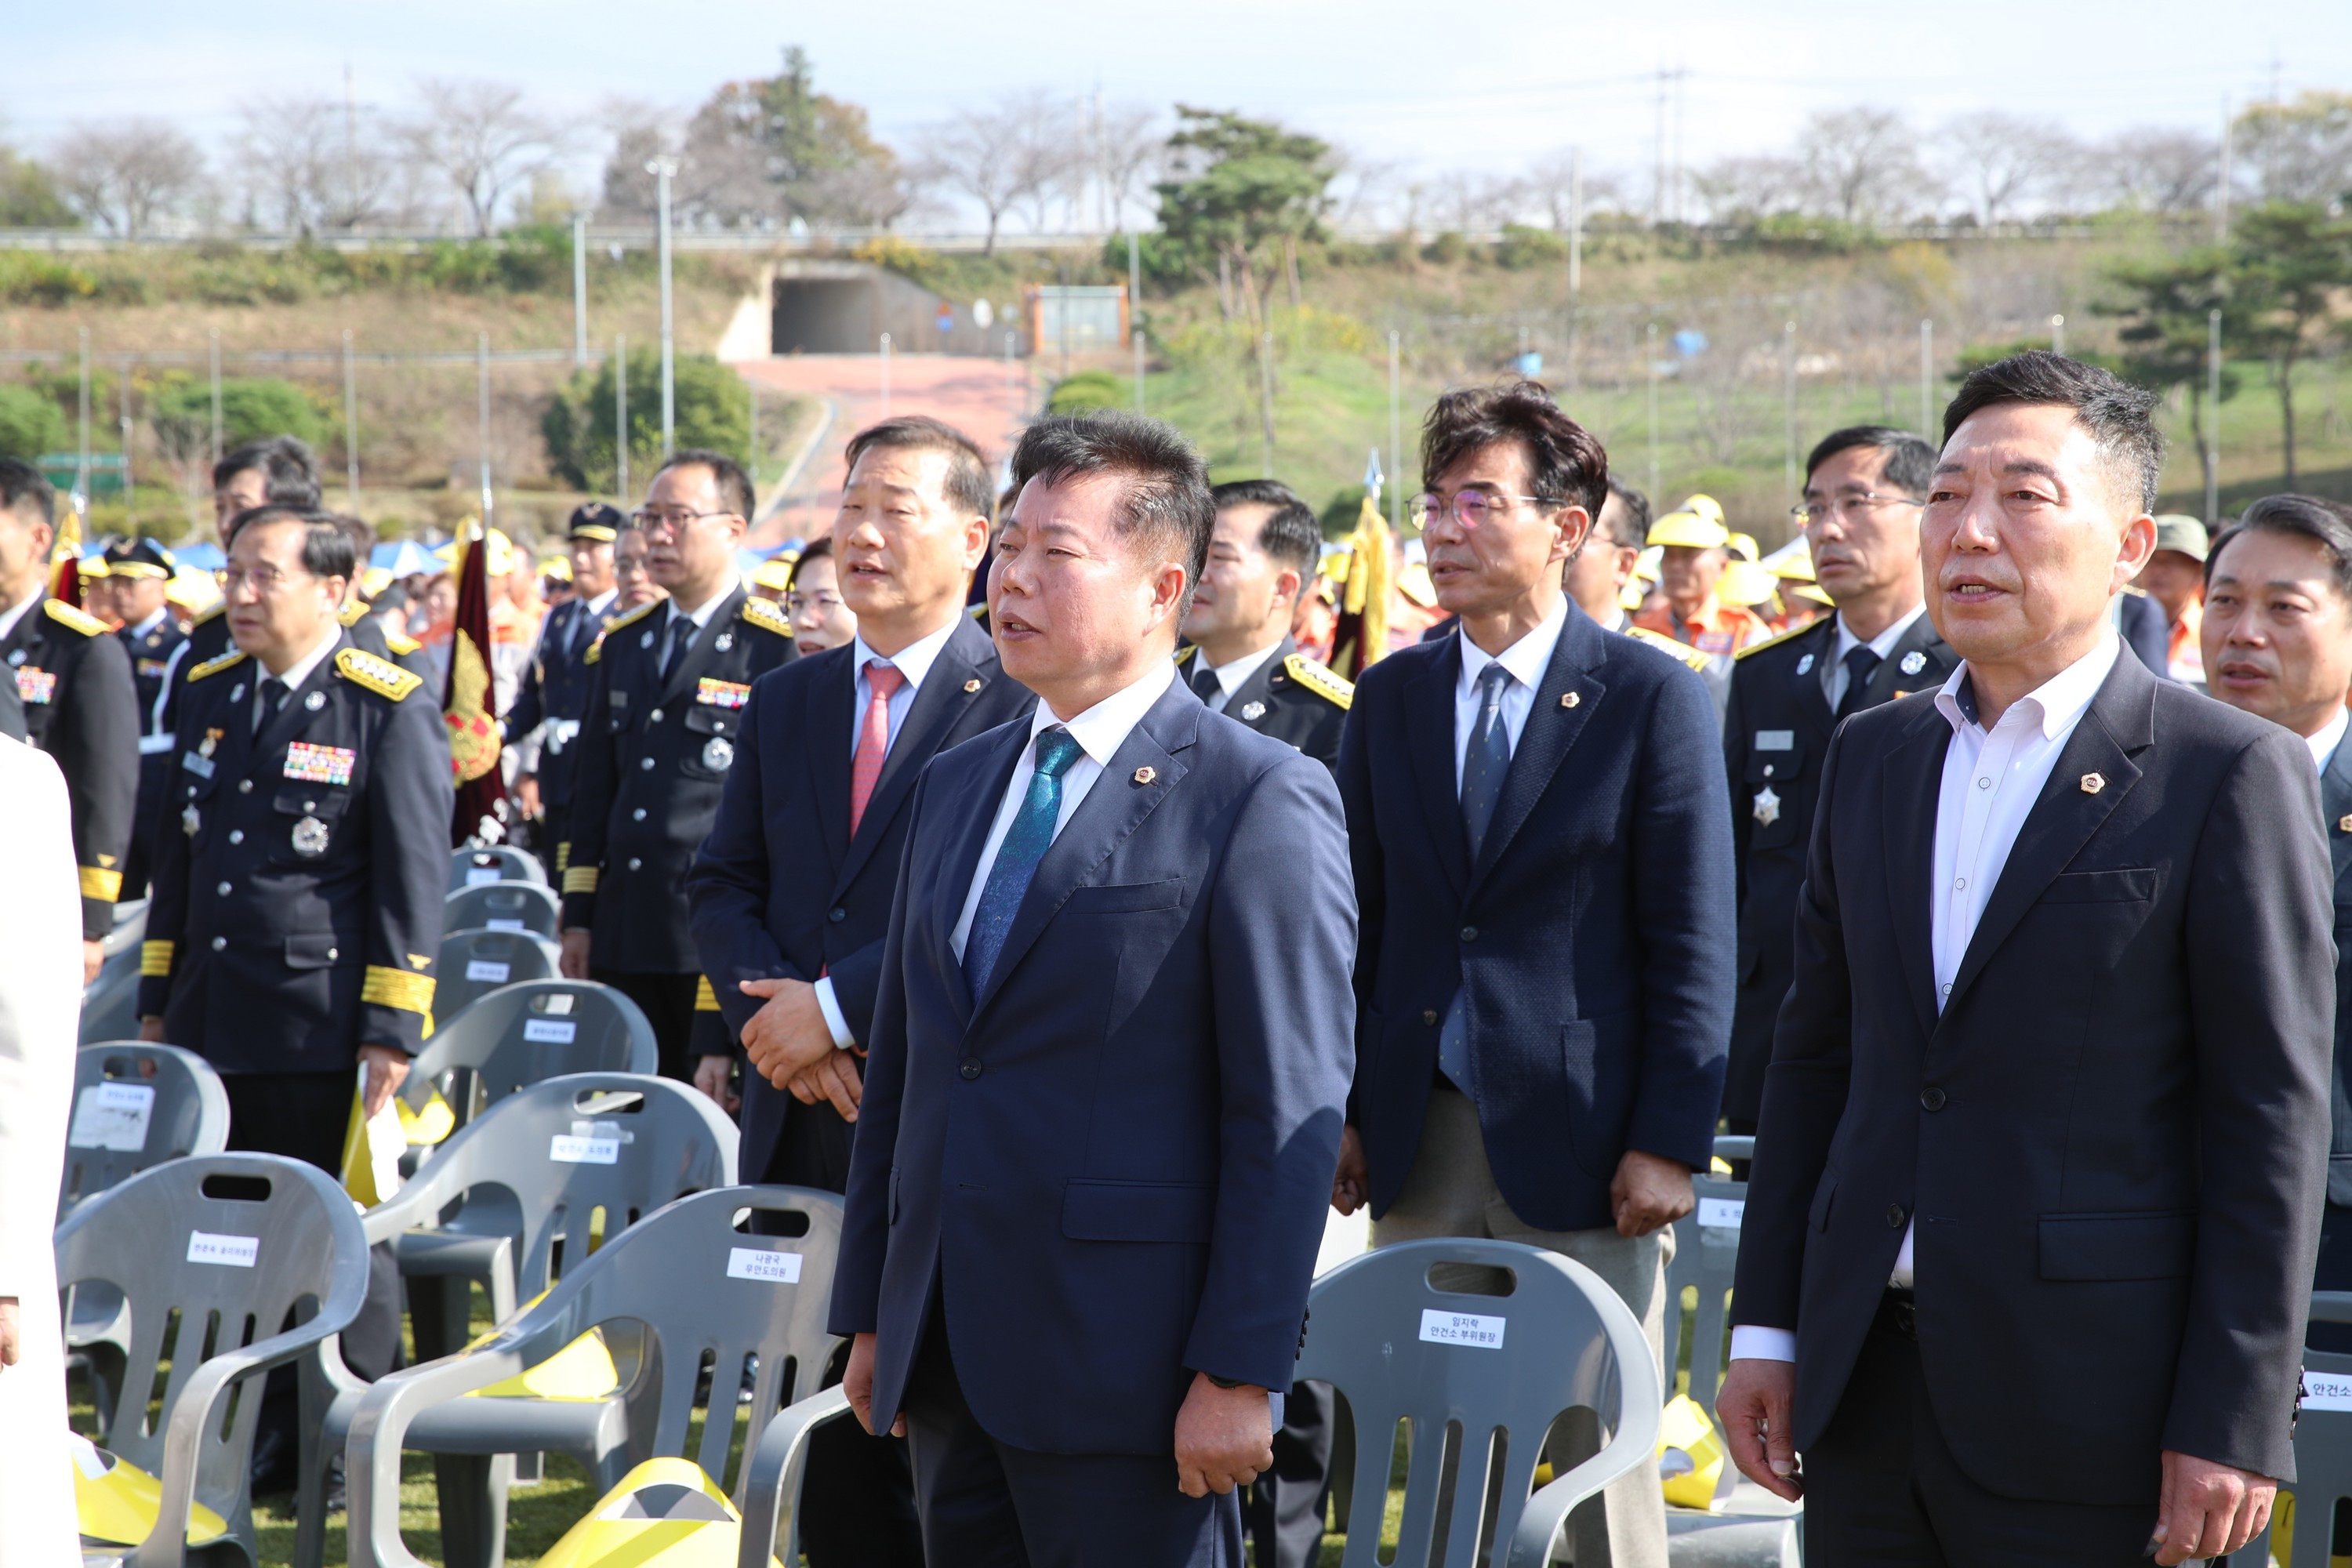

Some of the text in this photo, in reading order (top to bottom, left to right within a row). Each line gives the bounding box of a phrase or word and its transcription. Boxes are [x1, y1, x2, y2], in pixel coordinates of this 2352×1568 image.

[756, 1254, 780, 1265] 나광국
[745, 1264, 786, 1278] 무안도의원
[1452, 1316, 1479, 1329] 임지락
[1430, 1326, 1496, 1343] 안건소 부위원장
[2313, 1383, 2352, 1397] 안건소
